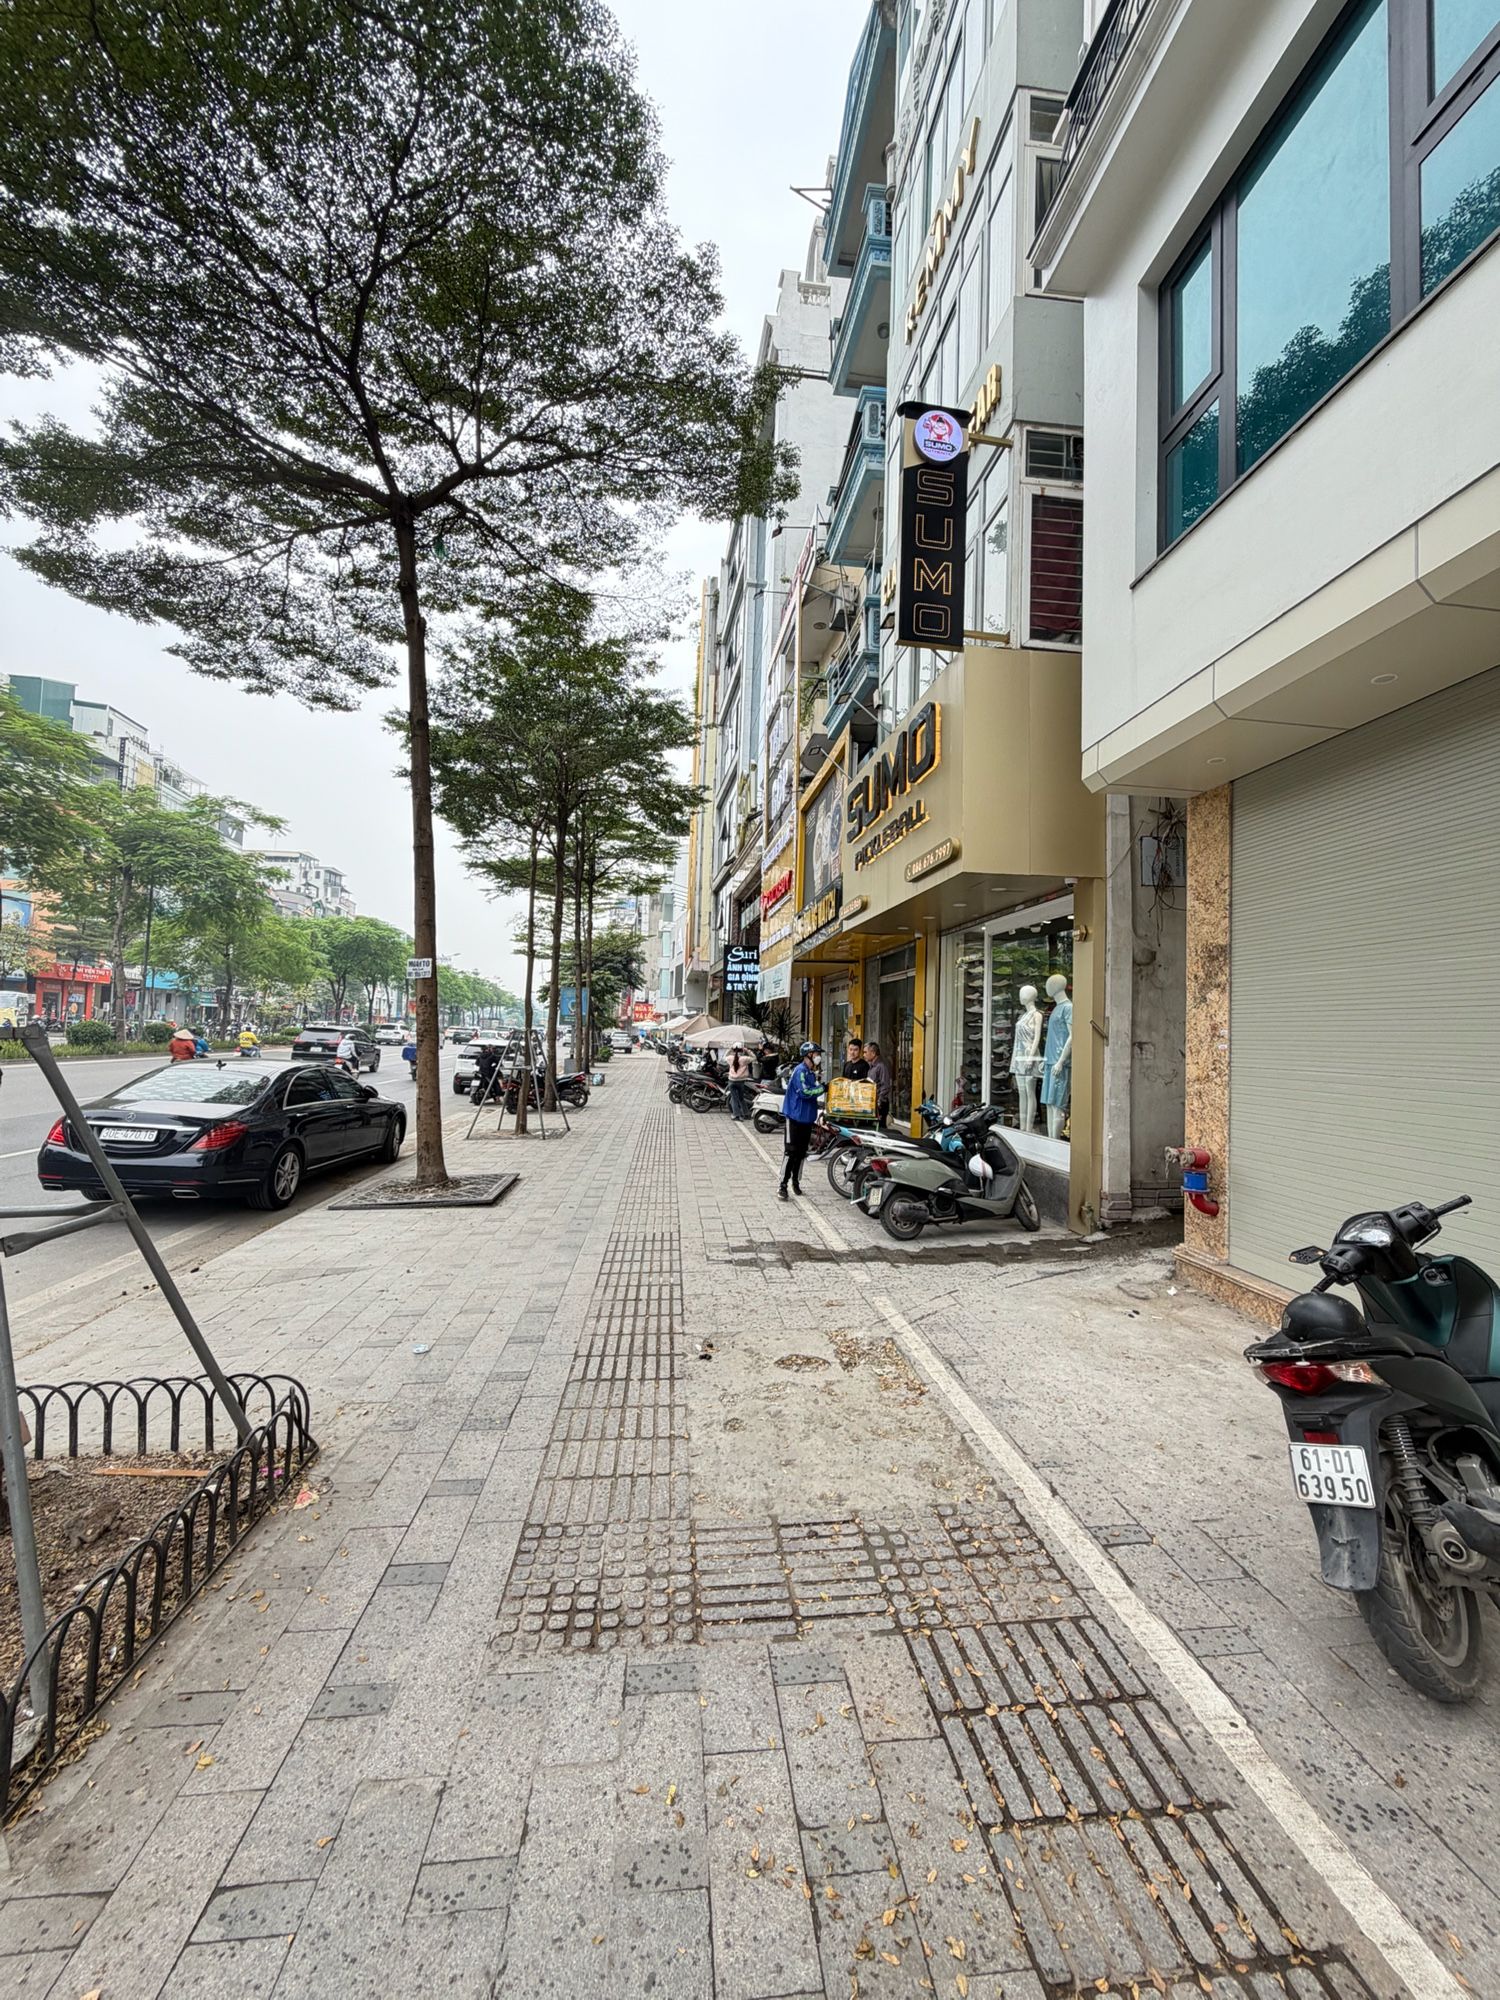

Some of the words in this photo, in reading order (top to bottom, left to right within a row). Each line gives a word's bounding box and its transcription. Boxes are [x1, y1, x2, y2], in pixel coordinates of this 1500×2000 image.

[925, 440, 953, 451] SUMO
[913, 469, 955, 639] SUMO
[847, 702, 941, 844] SUMO
[855, 800, 931, 871] PICKLEBALL
[728, 946, 757, 962] Suri
[727, 961, 743, 971] ẢNH
[728, 973, 740, 981] GIA
[726, 983, 732, 991] &
[1300, 1447, 1354, 1475] 61-D1
[1298, 1474, 1369, 1503] 639.50
